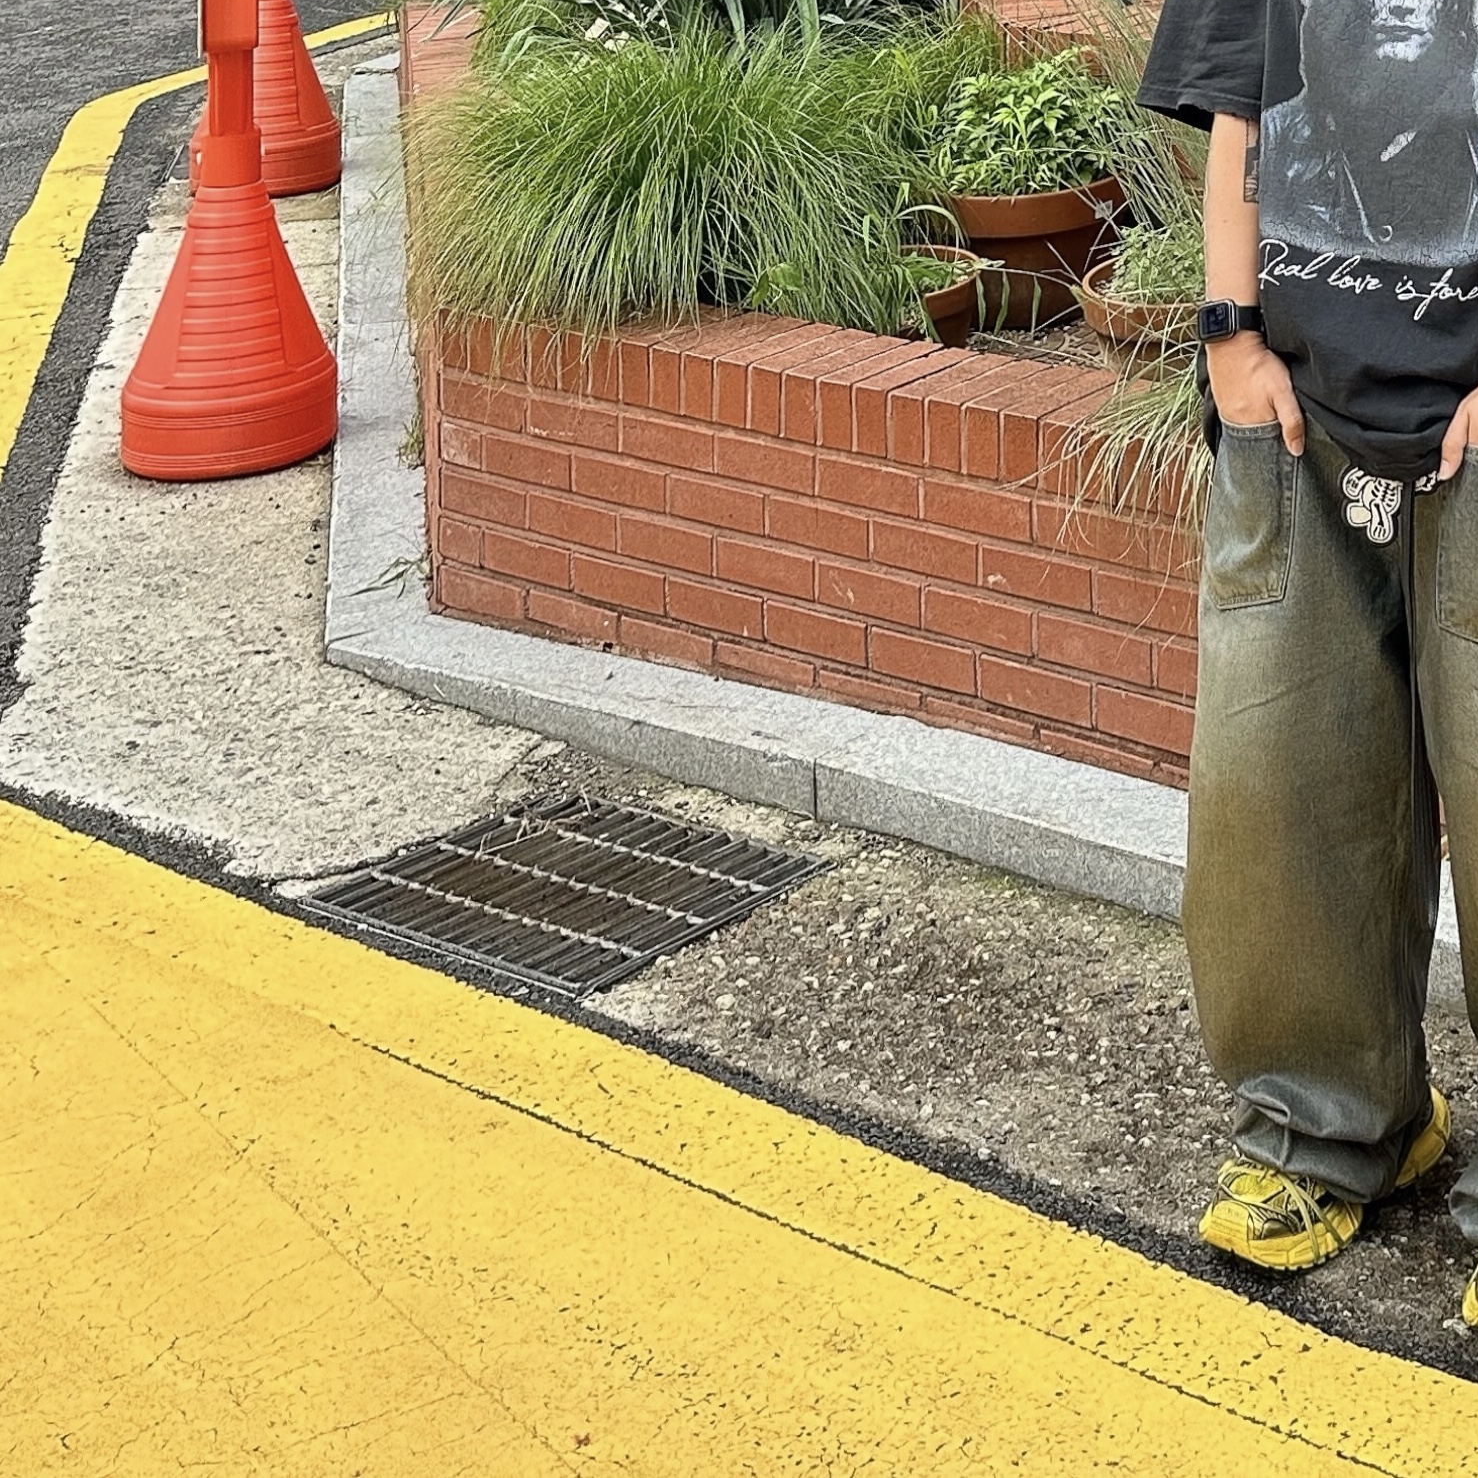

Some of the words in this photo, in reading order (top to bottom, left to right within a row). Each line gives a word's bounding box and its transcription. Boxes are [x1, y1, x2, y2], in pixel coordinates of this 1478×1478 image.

[1258, 239, 1335, 290] Real
[1327, 255, 1382, 295] love
[1395, 275, 1417, 301] is
